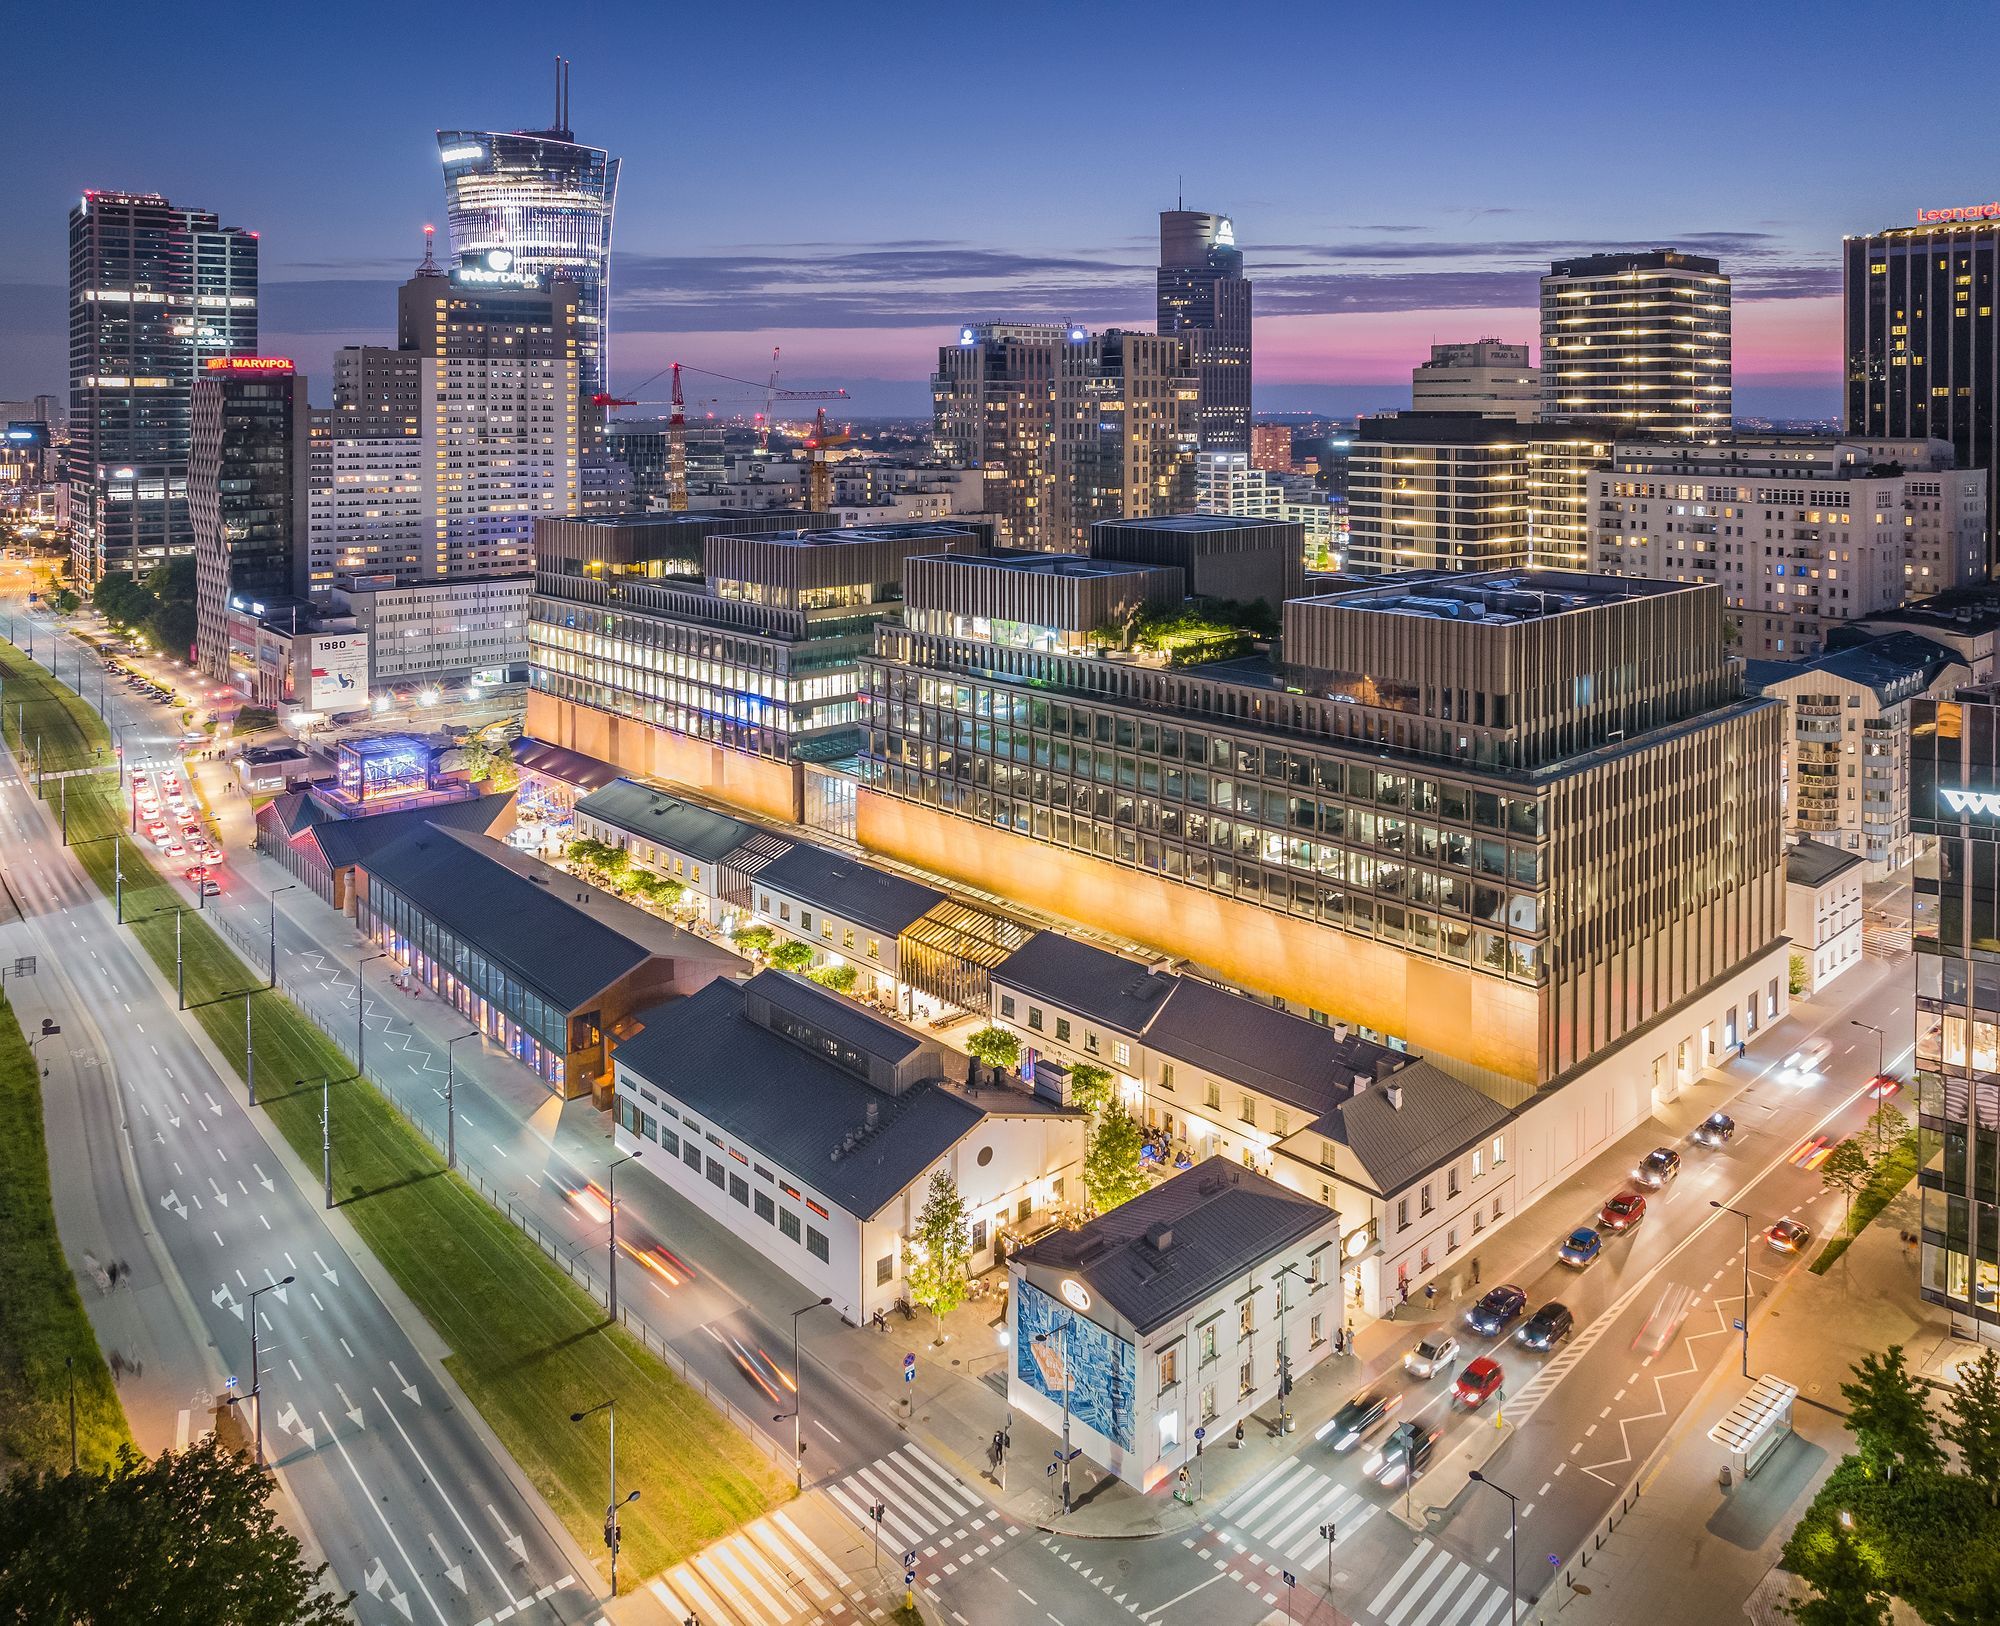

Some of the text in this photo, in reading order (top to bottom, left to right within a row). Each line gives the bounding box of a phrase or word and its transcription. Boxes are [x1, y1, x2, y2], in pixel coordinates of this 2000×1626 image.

[1917, 201, 2000, 222] Leonard
[232, 359, 294, 369] MARVIPOL
[318, 640, 347, 651] 1980
